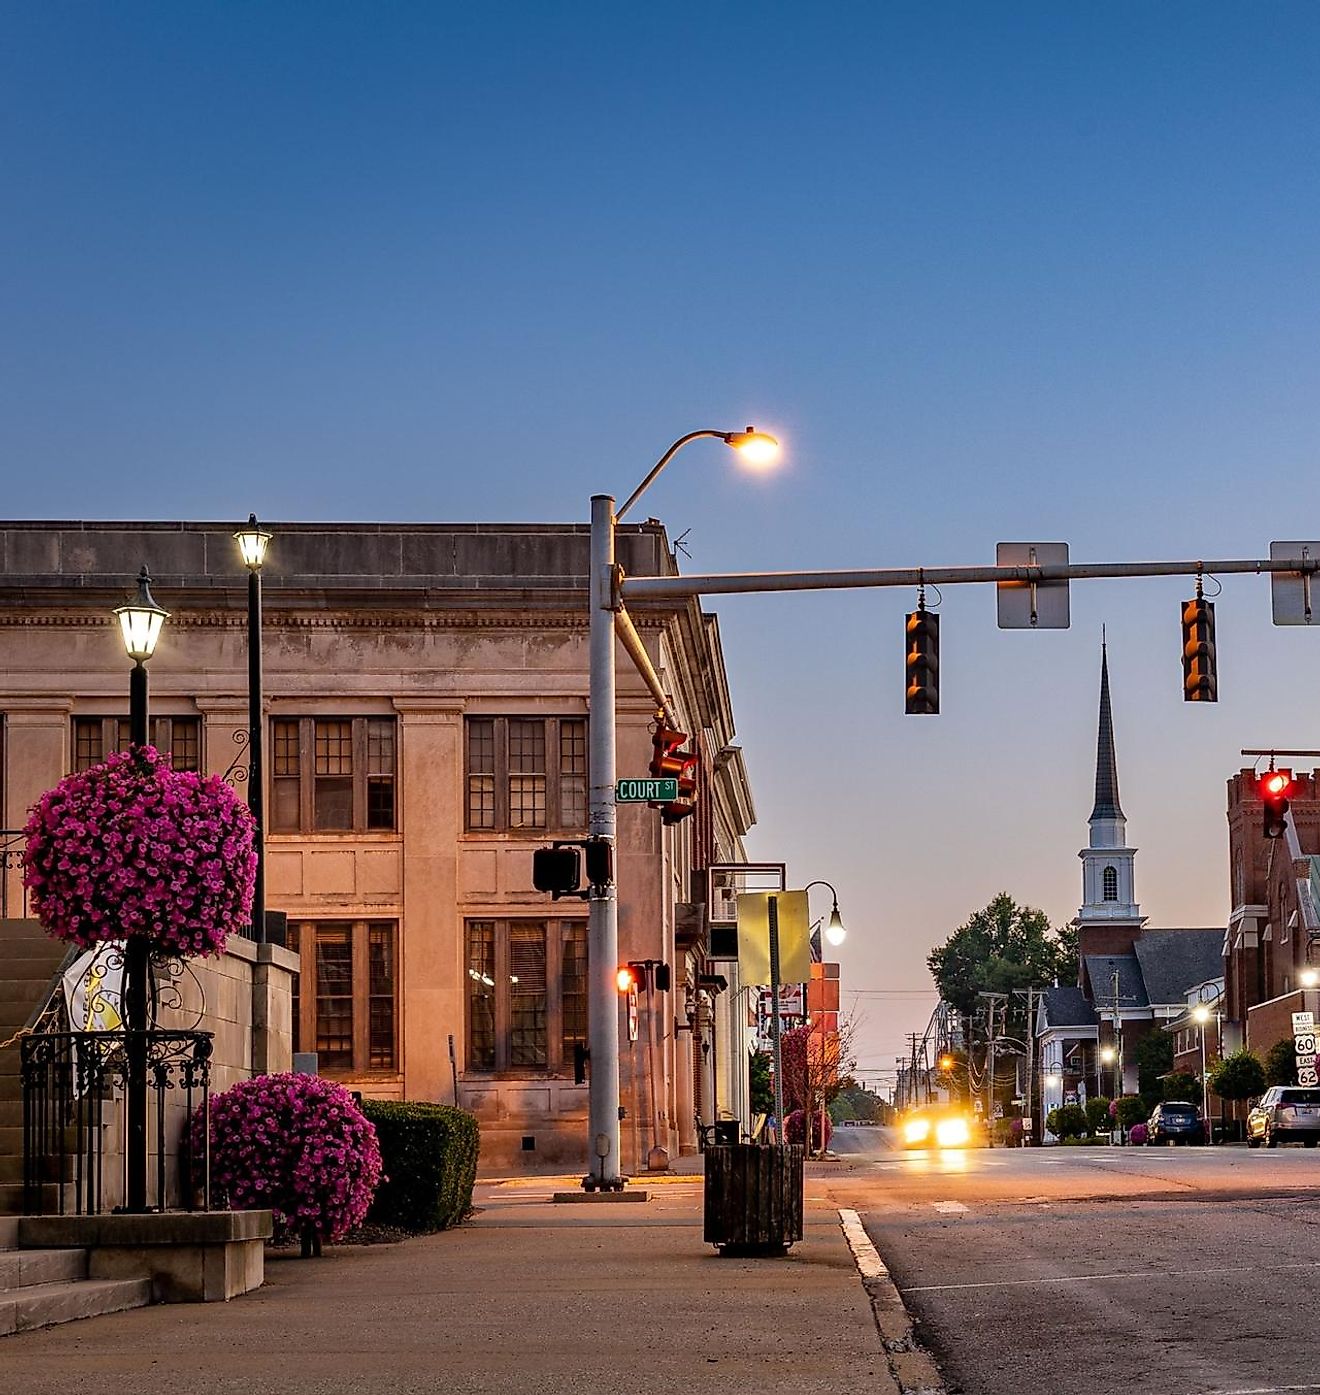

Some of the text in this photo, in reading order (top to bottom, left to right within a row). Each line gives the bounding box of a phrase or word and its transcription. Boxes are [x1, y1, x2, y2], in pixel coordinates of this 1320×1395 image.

[620, 781, 675, 798] COURT ST
[1297, 1039, 1313, 1051] 60
[1300, 1057, 1313, 1065] EAST
[1300, 1071, 1316, 1083] 62
